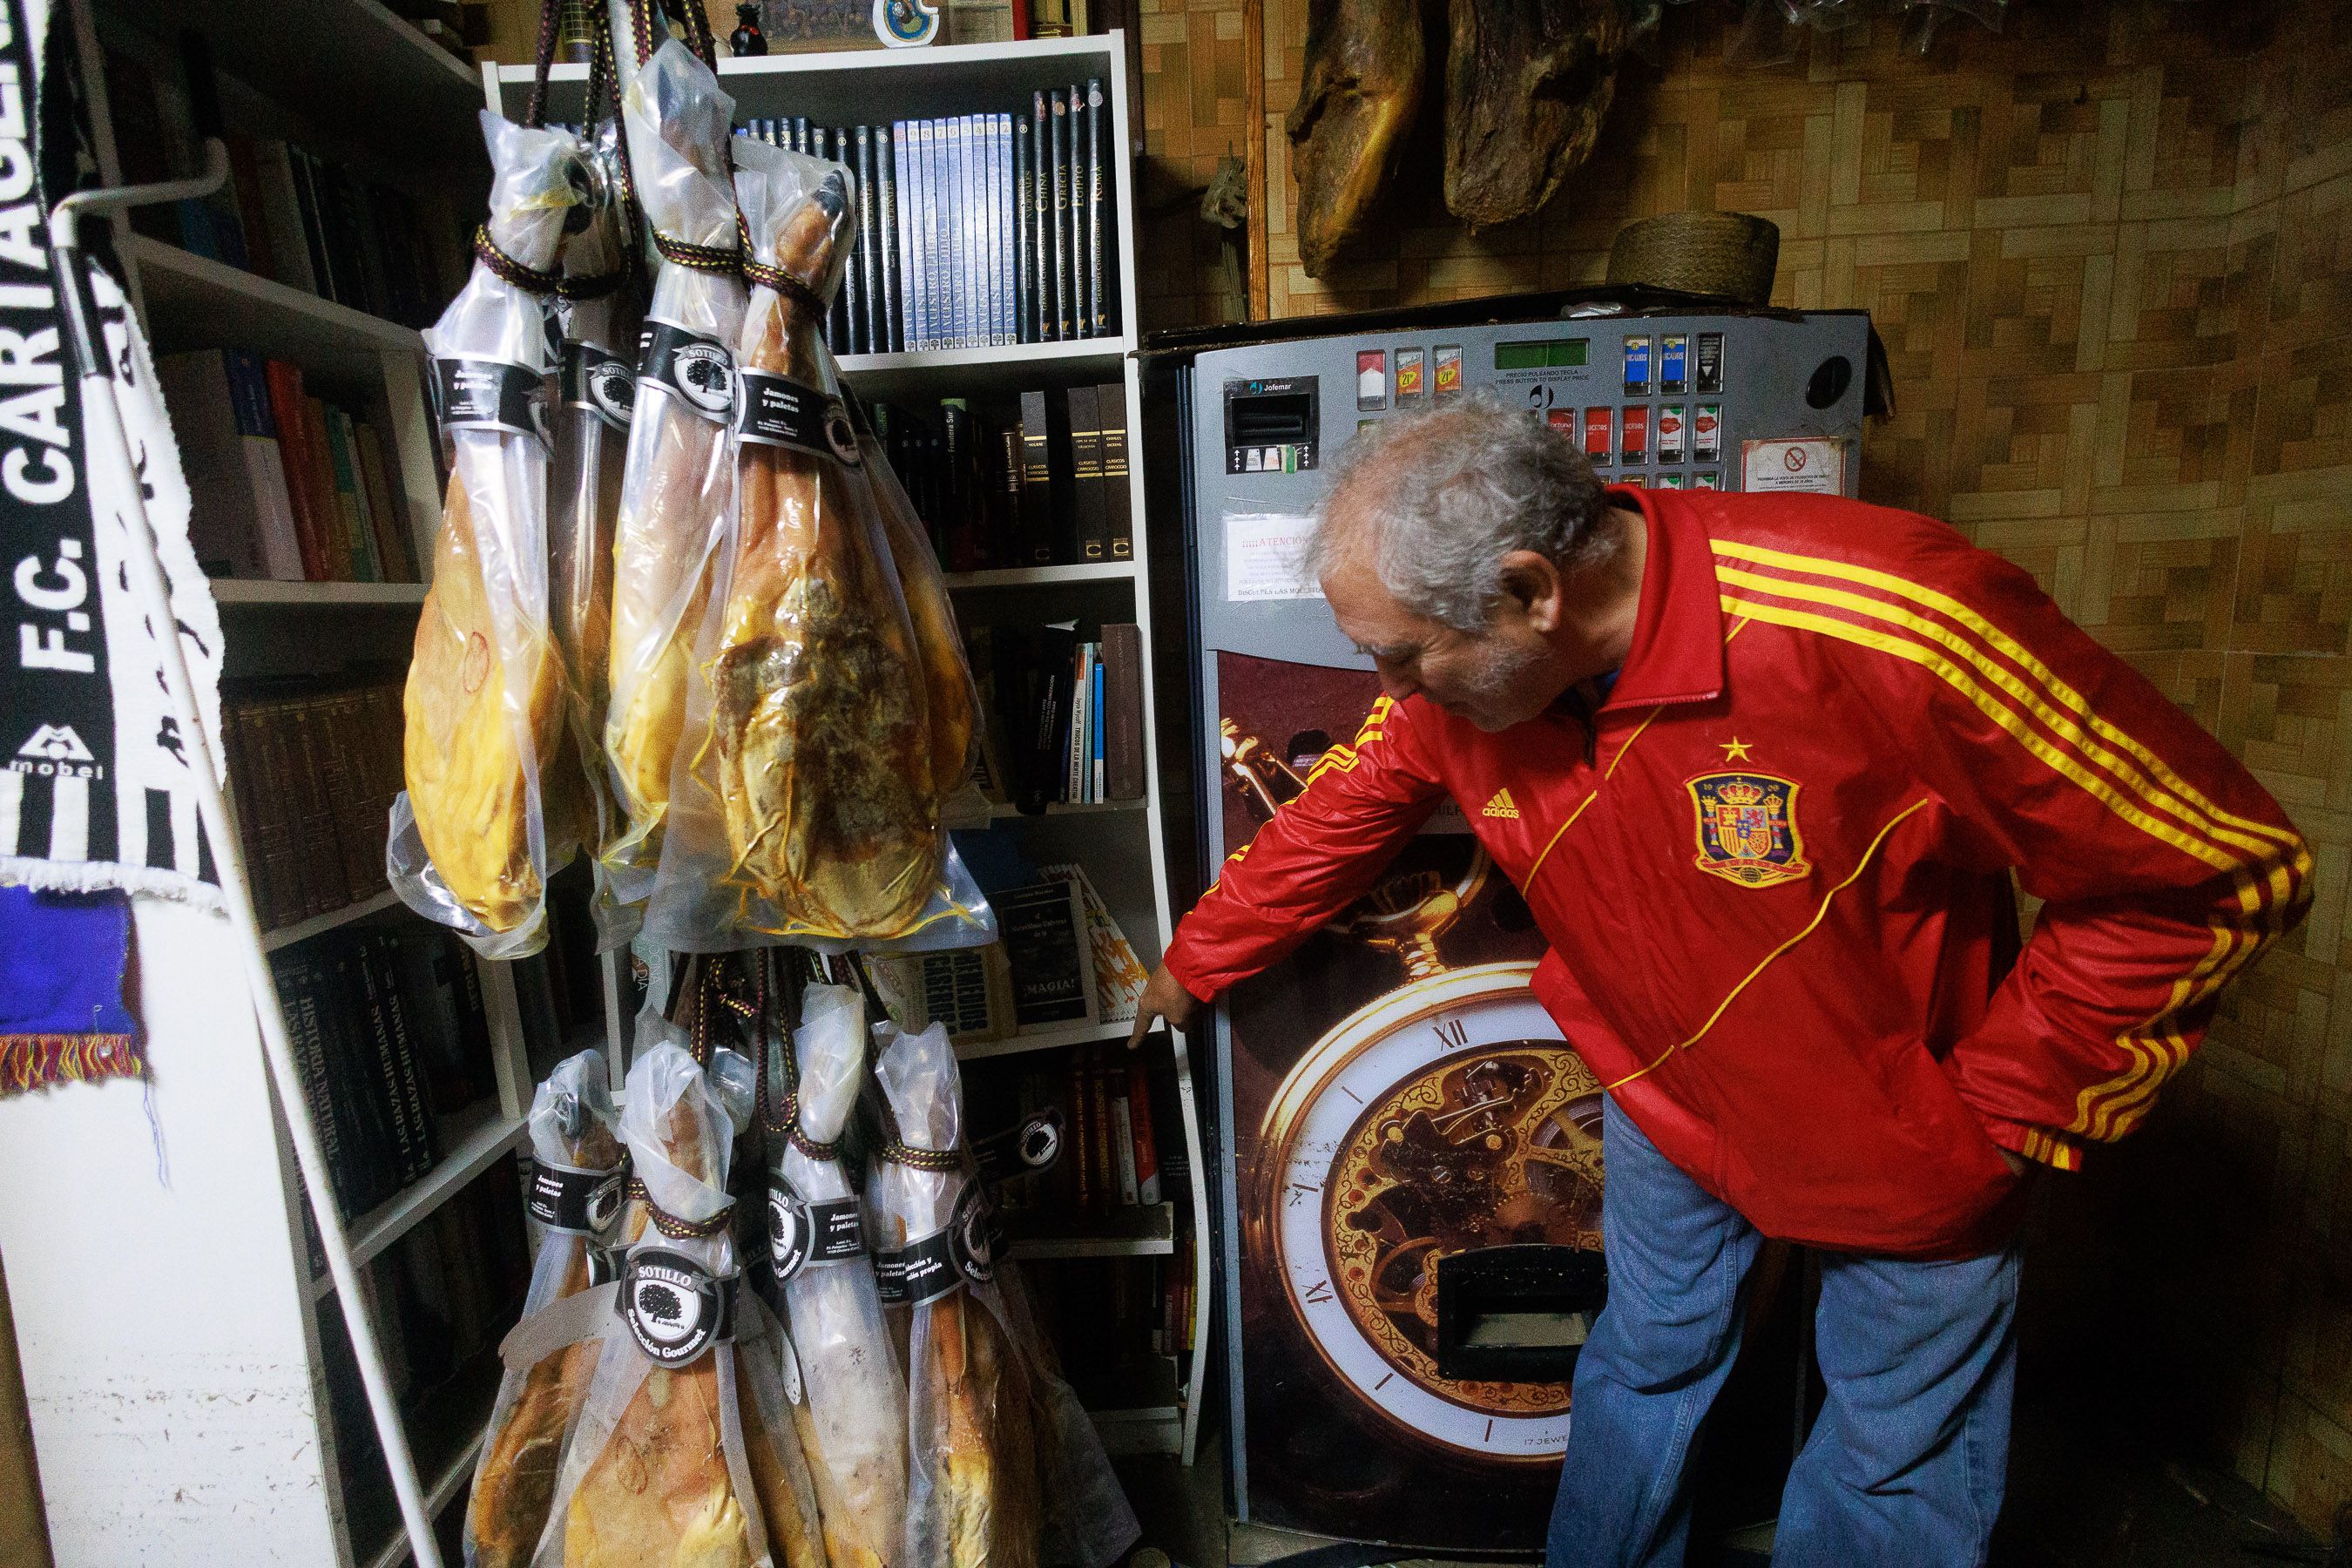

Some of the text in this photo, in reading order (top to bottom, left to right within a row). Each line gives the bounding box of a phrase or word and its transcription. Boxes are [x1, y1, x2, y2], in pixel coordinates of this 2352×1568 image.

[1035, 172, 1048, 212] CHINA
[1057, 165, 1068, 209] GRECIA
[1072, 165, 1084, 208] EGIPTO
[1090, 166, 1103, 202] ROMA
[928, 272, 938, 328] VUESTRO
[941, 270, 951, 327] VUESTRO
[763, 387, 800, 402] Jamones
[770, 401, 800, 413] paletas
[947, 424, 956, 453] Frontera
[12, 538, 95, 673] F.C.
[9, 759, 103, 780] mobel
[1482, 807, 1519, 819] adidas
[1432, 1019, 1469, 1051] XII
[298, 997, 327, 1079] HISTORIA
[313, 1078, 341, 1160] NATURAL
[371, 1004, 411, 1155] LAS RAZAS HUMANAS
[389, 995, 426, 1142] LAS RAZAS HUMANAS
[537, 1174, 564, 1188] Jamones
[539, 1186, 562, 1198] paletas
[830, 1212, 858, 1221] Jamones
[837, 1221, 859, 1232] paletas
[639, 1266, 692, 1287] SOTILLO
[920, 1261, 943, 1278] propia
[628, 1308, 706, 1359] Selección Gourmet
